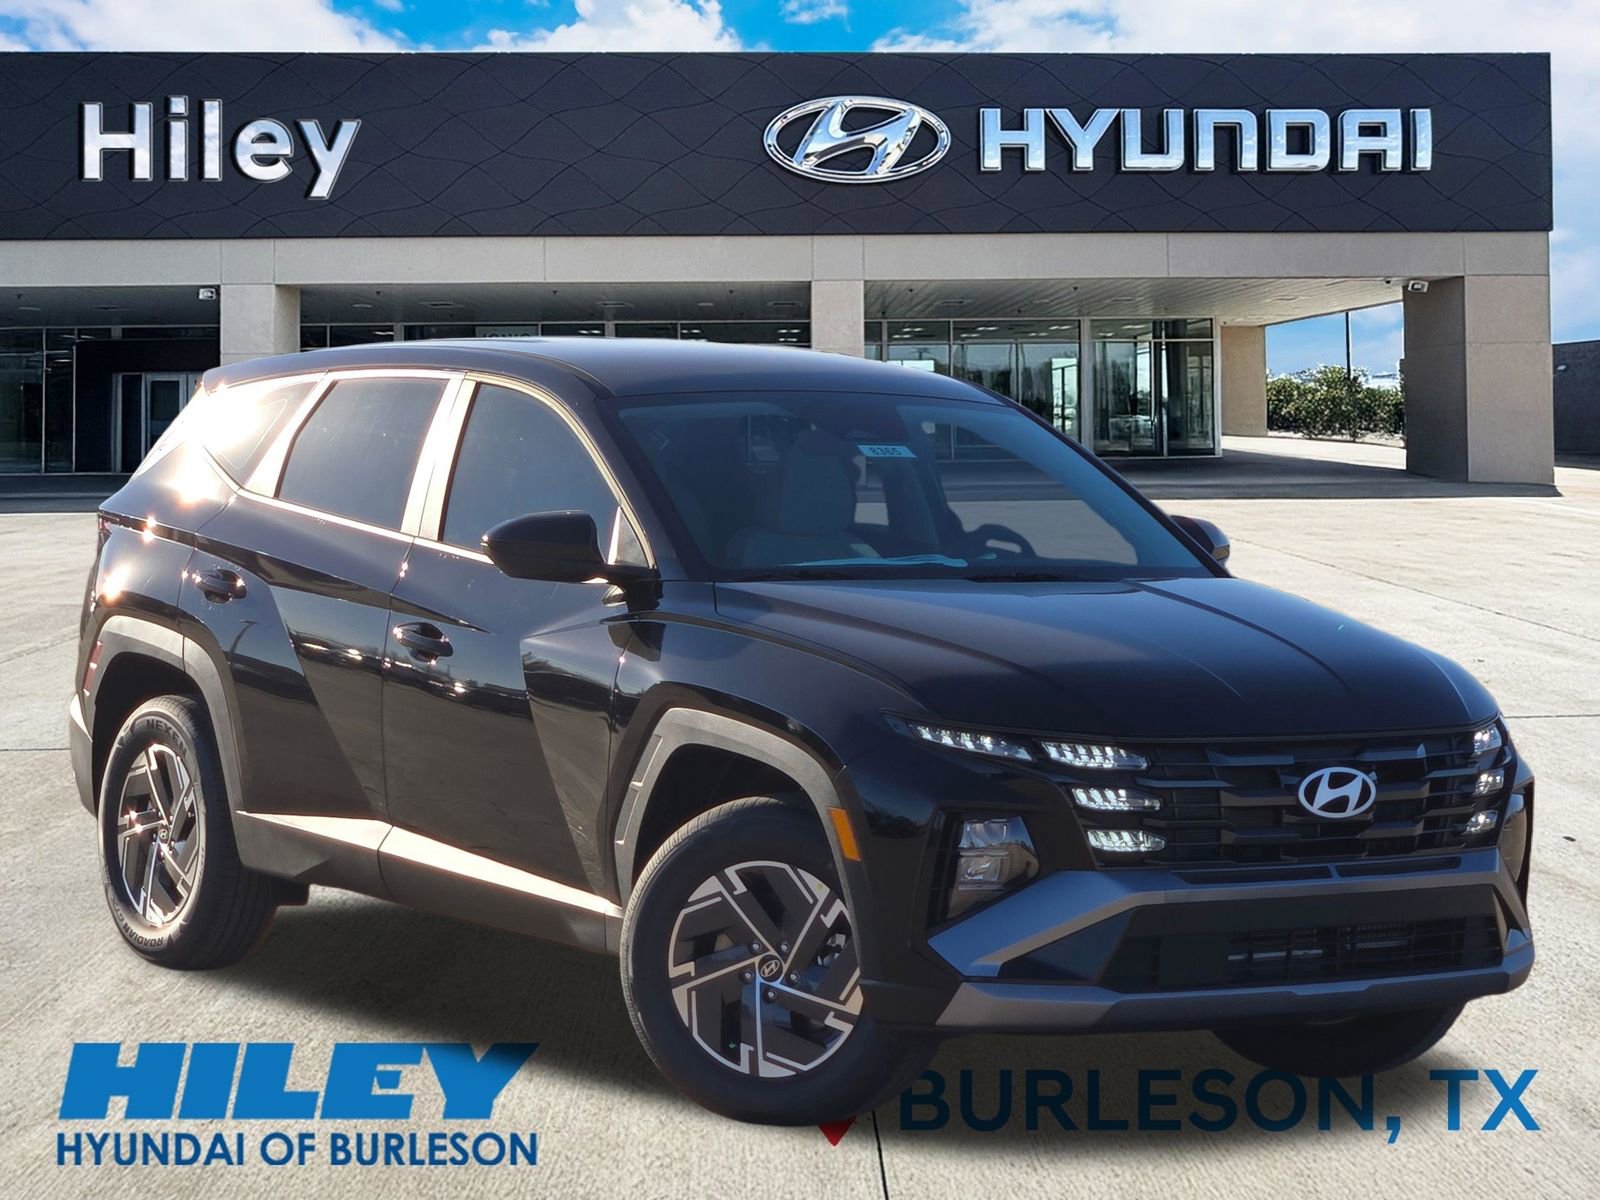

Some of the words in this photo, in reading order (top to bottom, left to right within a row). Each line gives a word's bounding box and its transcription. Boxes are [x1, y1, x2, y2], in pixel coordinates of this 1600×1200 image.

[81, 95, 362, 200] Hiley
[979, 107, 1434, 173] HYUNDAI
[146, 718, 188, 755] NEXEN
[122, 922, 164, 948] ROADIAN
